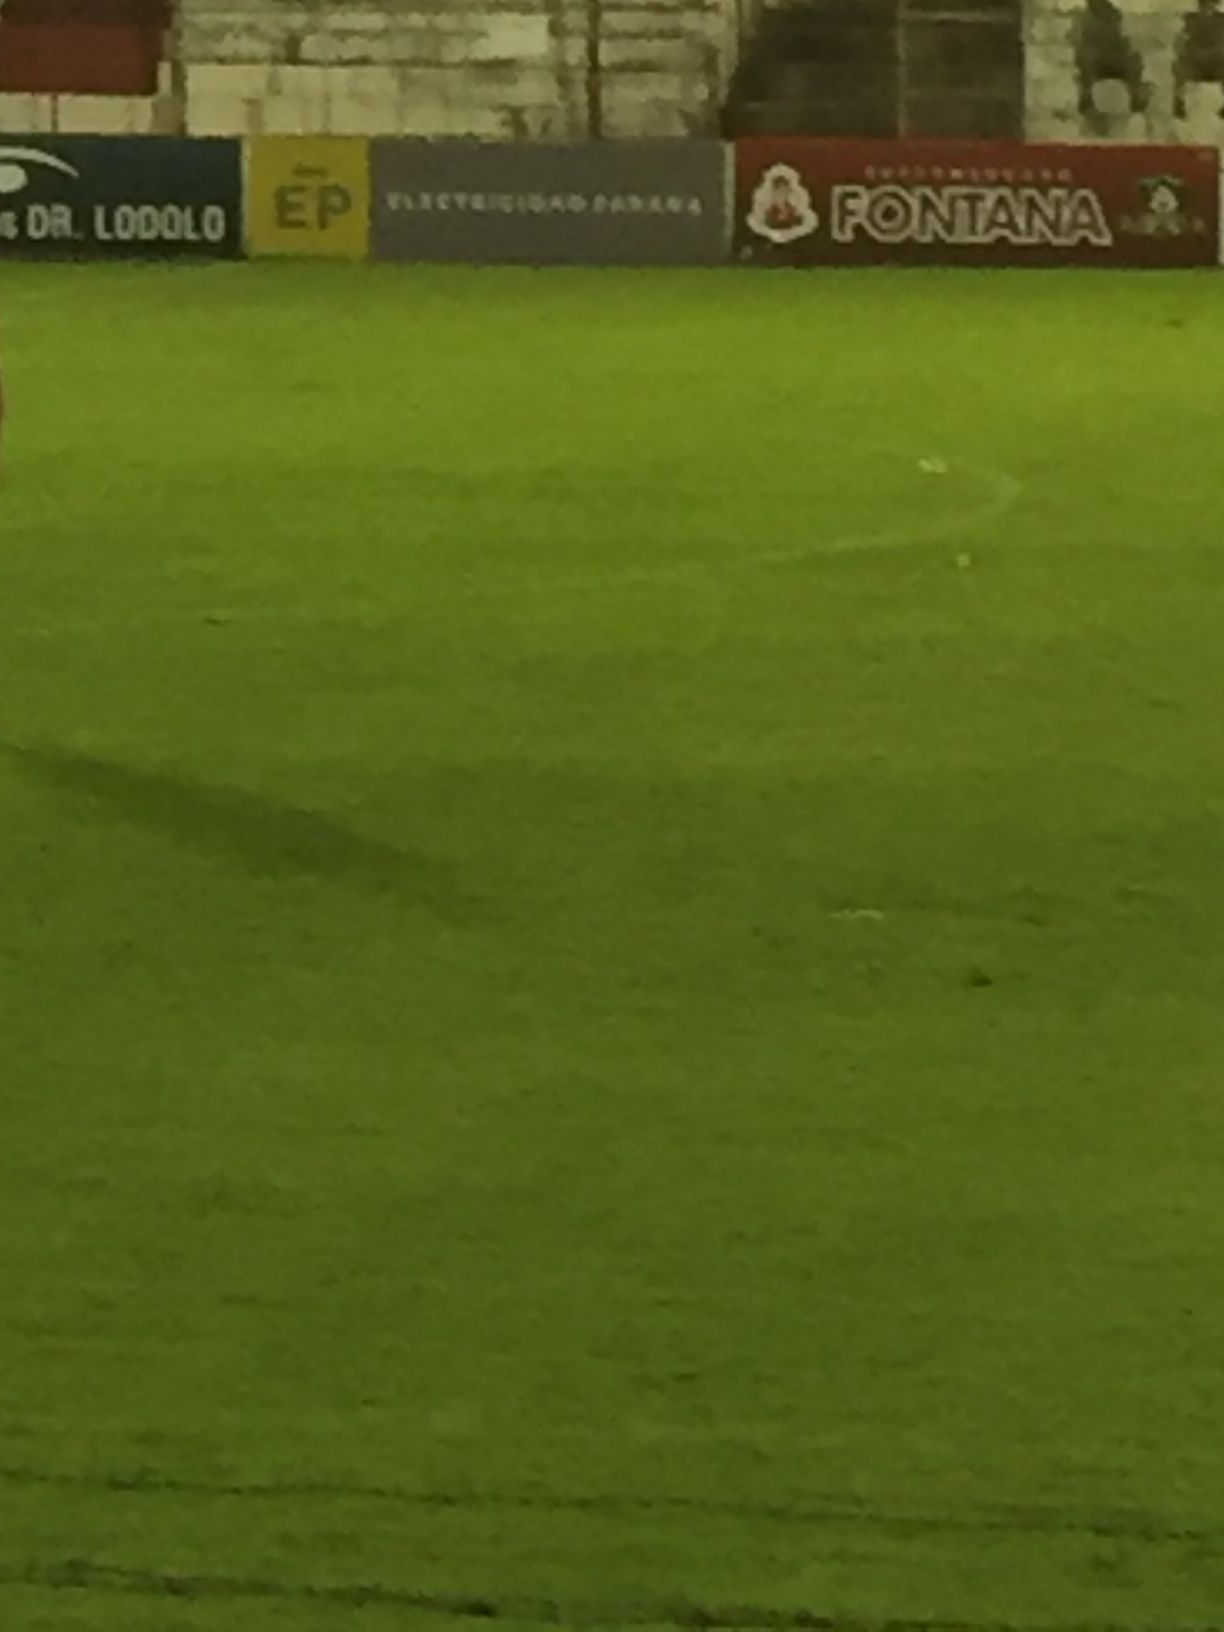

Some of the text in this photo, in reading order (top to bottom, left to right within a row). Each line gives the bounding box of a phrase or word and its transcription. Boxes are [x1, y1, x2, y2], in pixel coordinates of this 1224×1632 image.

[94, 205, 226, 242] LODOLO
[273, 183, 353, 230] EP
[831, 185, 1114, 247] FONTANA
